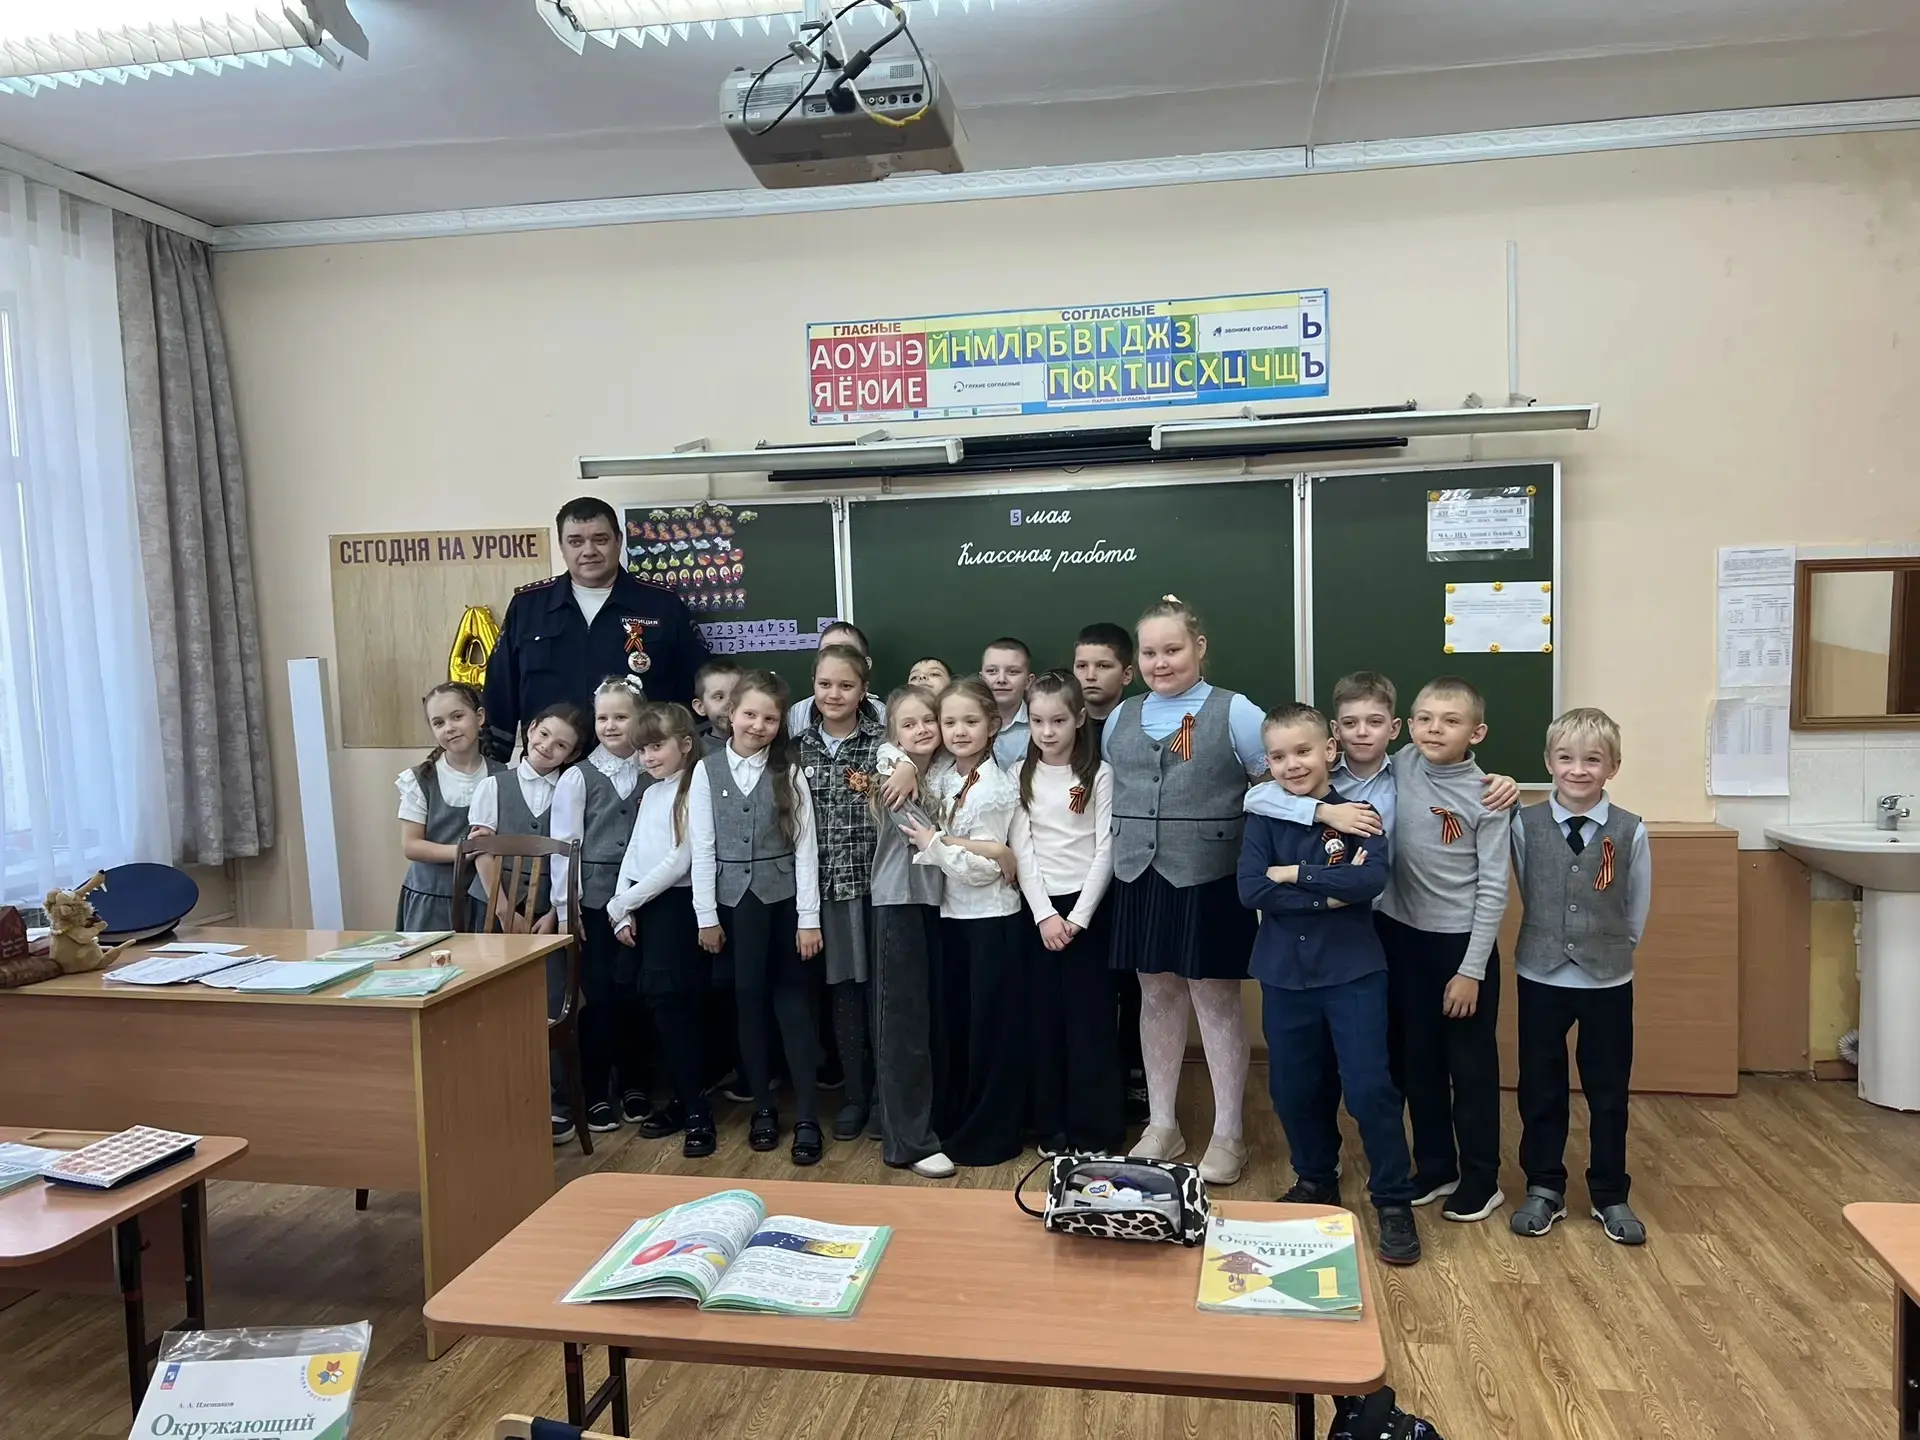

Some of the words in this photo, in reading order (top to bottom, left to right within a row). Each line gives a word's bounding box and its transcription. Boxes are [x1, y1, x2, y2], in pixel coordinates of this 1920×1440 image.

[1061, 304, 1155, 322] СОГЛАСНЫЕ
[833, 322, 901, 337] ГЛАСНЫЕ
[1252, 324, 1289, 332] СОГЛАСНЫЕ
[1025, 509, 1072, 524] мая
[340, 538, 430, 566] СЕГОДНЯ
[438, 536, 465, 561] НА
[472, 534, 538, 560] УРОКЕ
[957, 541, 1052, 566] Классная
[1052, 539, 1137, 572] работа
[1306, 1266, 1348, 1299] 1
[150, 1412, 316, 1440] Окружающий
